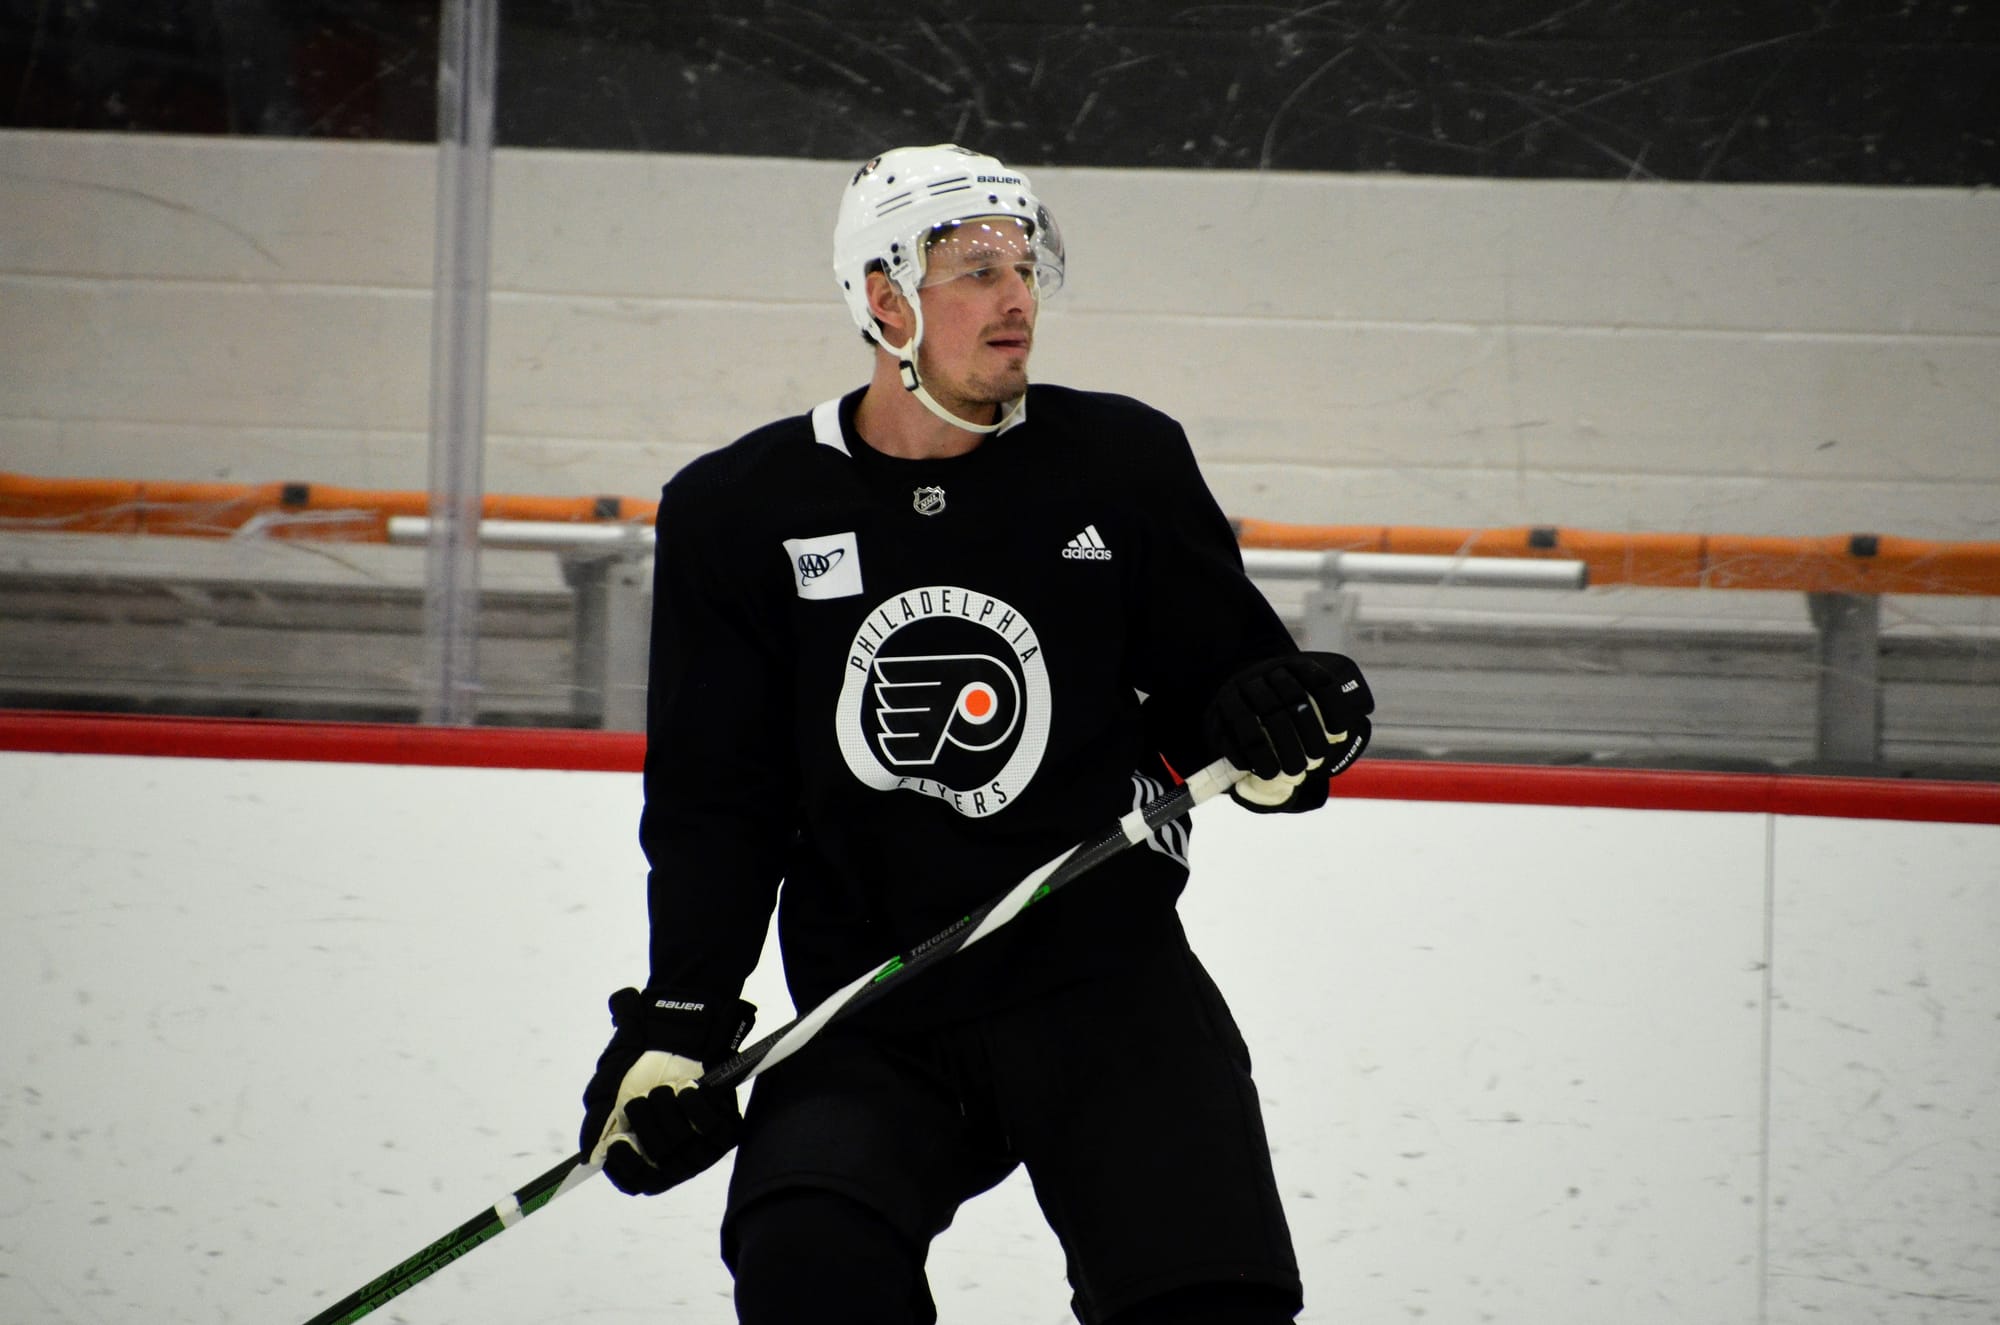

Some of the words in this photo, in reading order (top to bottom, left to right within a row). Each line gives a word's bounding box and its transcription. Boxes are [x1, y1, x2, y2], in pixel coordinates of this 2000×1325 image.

[977, 175, 1022, 186] BAUER
[920, 494, 939, 509] NHL
[1062, 546, 1112, 560] adidas
[799, 554, 829, 578] AAA
[850, 590, 1039, 672] PHILADELPHIA
[897, 777, 1008, 815] FLYERS
[911, 919, 965, 957] TRIGGER
[655, 999, 705, 1012] BAUER
